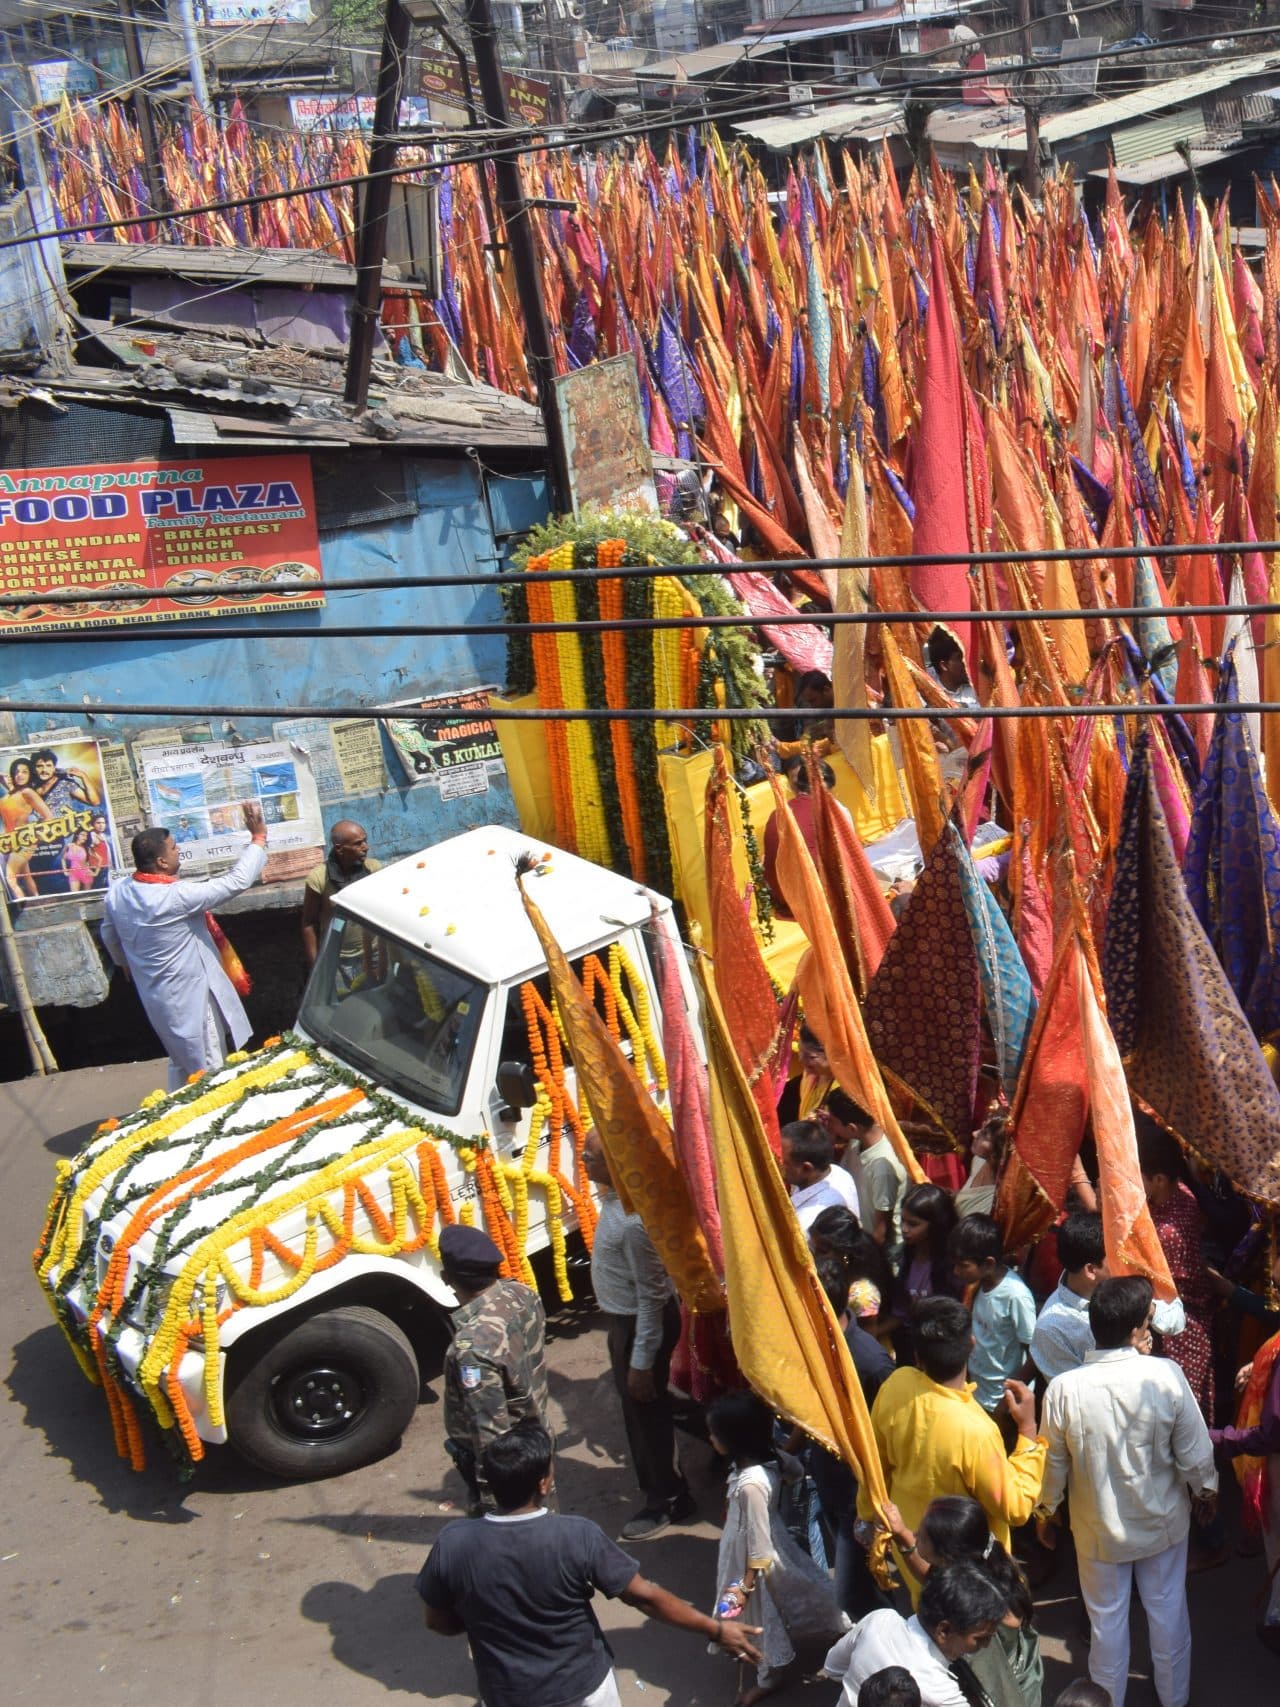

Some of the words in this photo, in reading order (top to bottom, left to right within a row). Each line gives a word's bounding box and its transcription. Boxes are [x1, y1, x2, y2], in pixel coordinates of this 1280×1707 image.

[422, 61, 453, 79] SRI
[509, 88, 547, 107] INN
[0, 467, 203, 495] Annapurna
[139, 481, 302, 517] PLAZA
[145, 514, 207, 528] Family
[211, 508, 306, 524] Restaurant
[163, 523, 282, 541] BREAKFAST
[0, 538, 59, 552] OUTH
[65, 532, 141, 548] INDIAN
[165, 539, 234, 553] LUNCH
[0, 549, 81, 565] HINESE
[167, 551, 244, 566] DINNER
[0, 557, 137, 577] ONTINENTAL
[71, 568, 146, 584] INDIAN
[0, 622, 81, 635] HARAMSHALA
[123, 614, 153, 625] NEAR
[156, 612, 176, 622] SBI
[216, 605, 257, 616] JHARIA
[260, 599, 323, 612] (DHANBAD)
[200, 751, 246, 766] देशबन्धु
[0, 805, 94, 853] लतखोर
[206, 845, 233, 856] भारत
